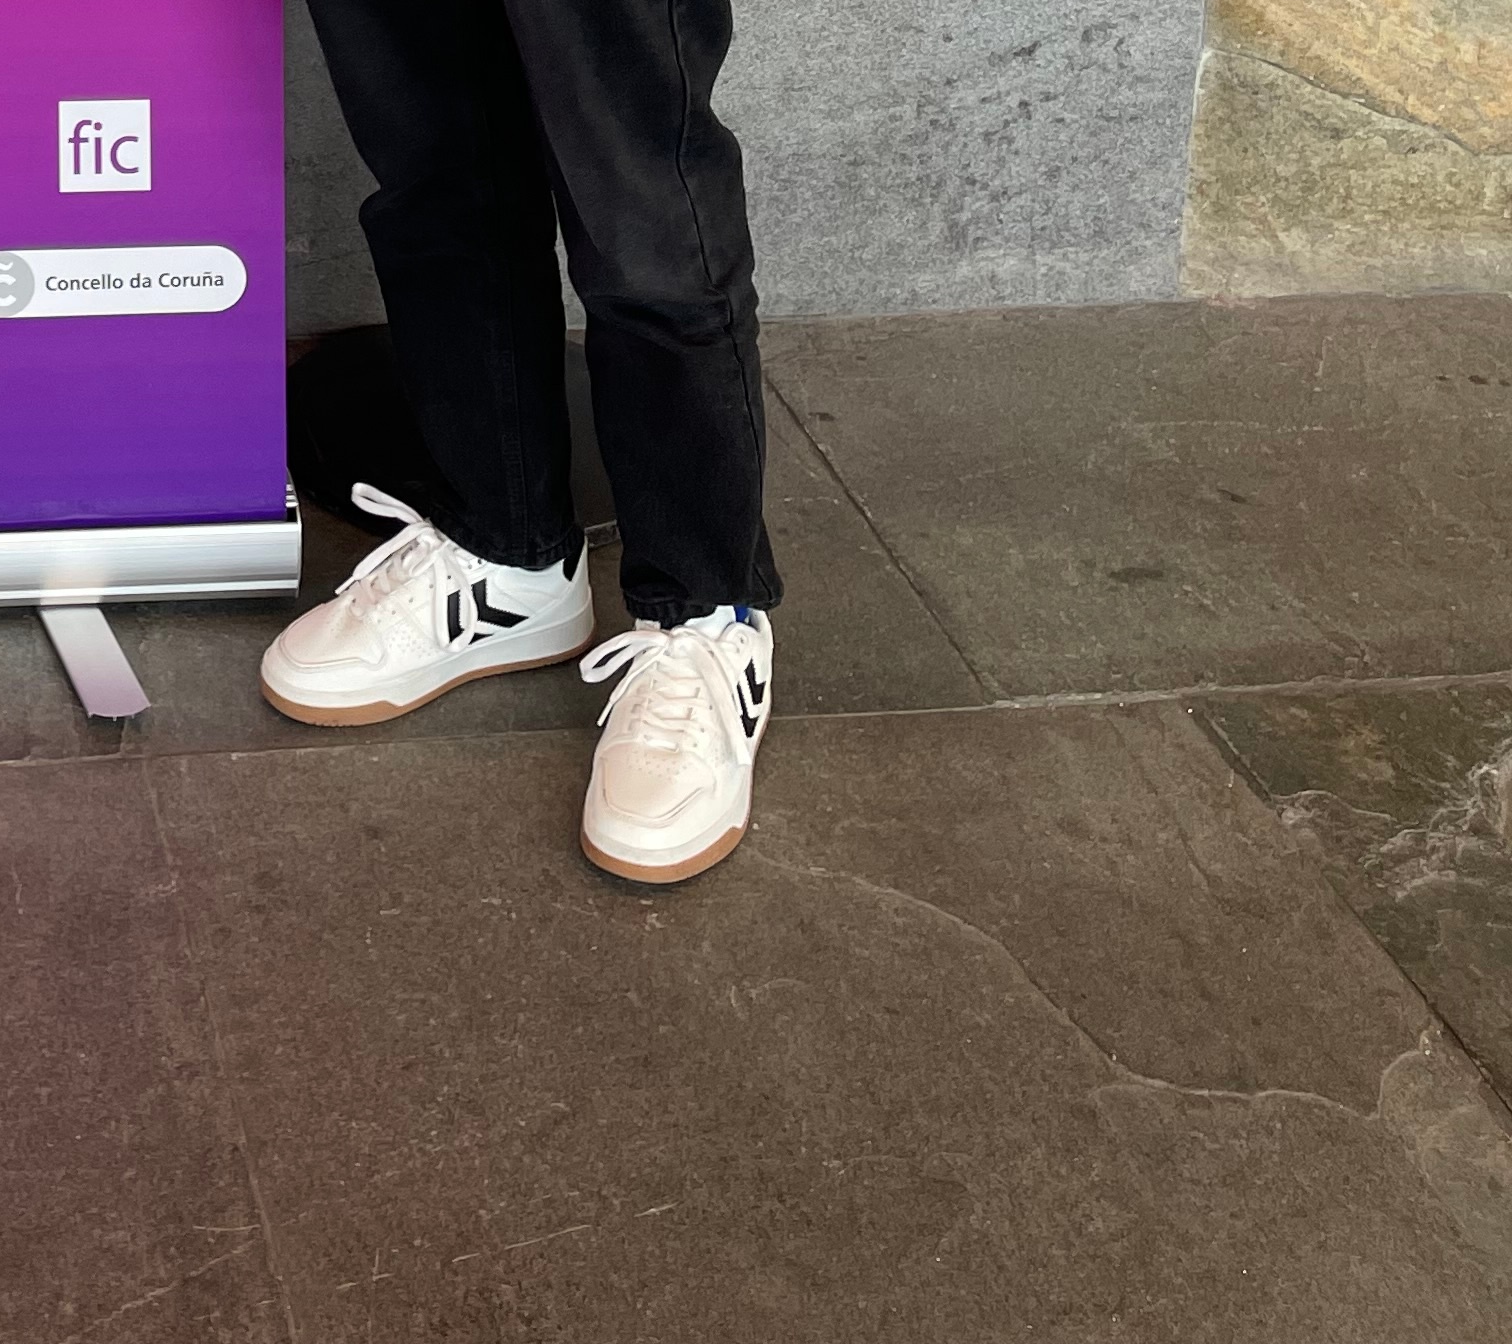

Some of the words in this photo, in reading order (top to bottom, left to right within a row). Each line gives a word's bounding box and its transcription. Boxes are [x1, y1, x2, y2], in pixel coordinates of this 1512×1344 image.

[67, 119, 140, 175] fic
[45, 273, 124, 292] Concello
[130, 272, 152, 289] da
[158, 271, 225, 288] Coruña
